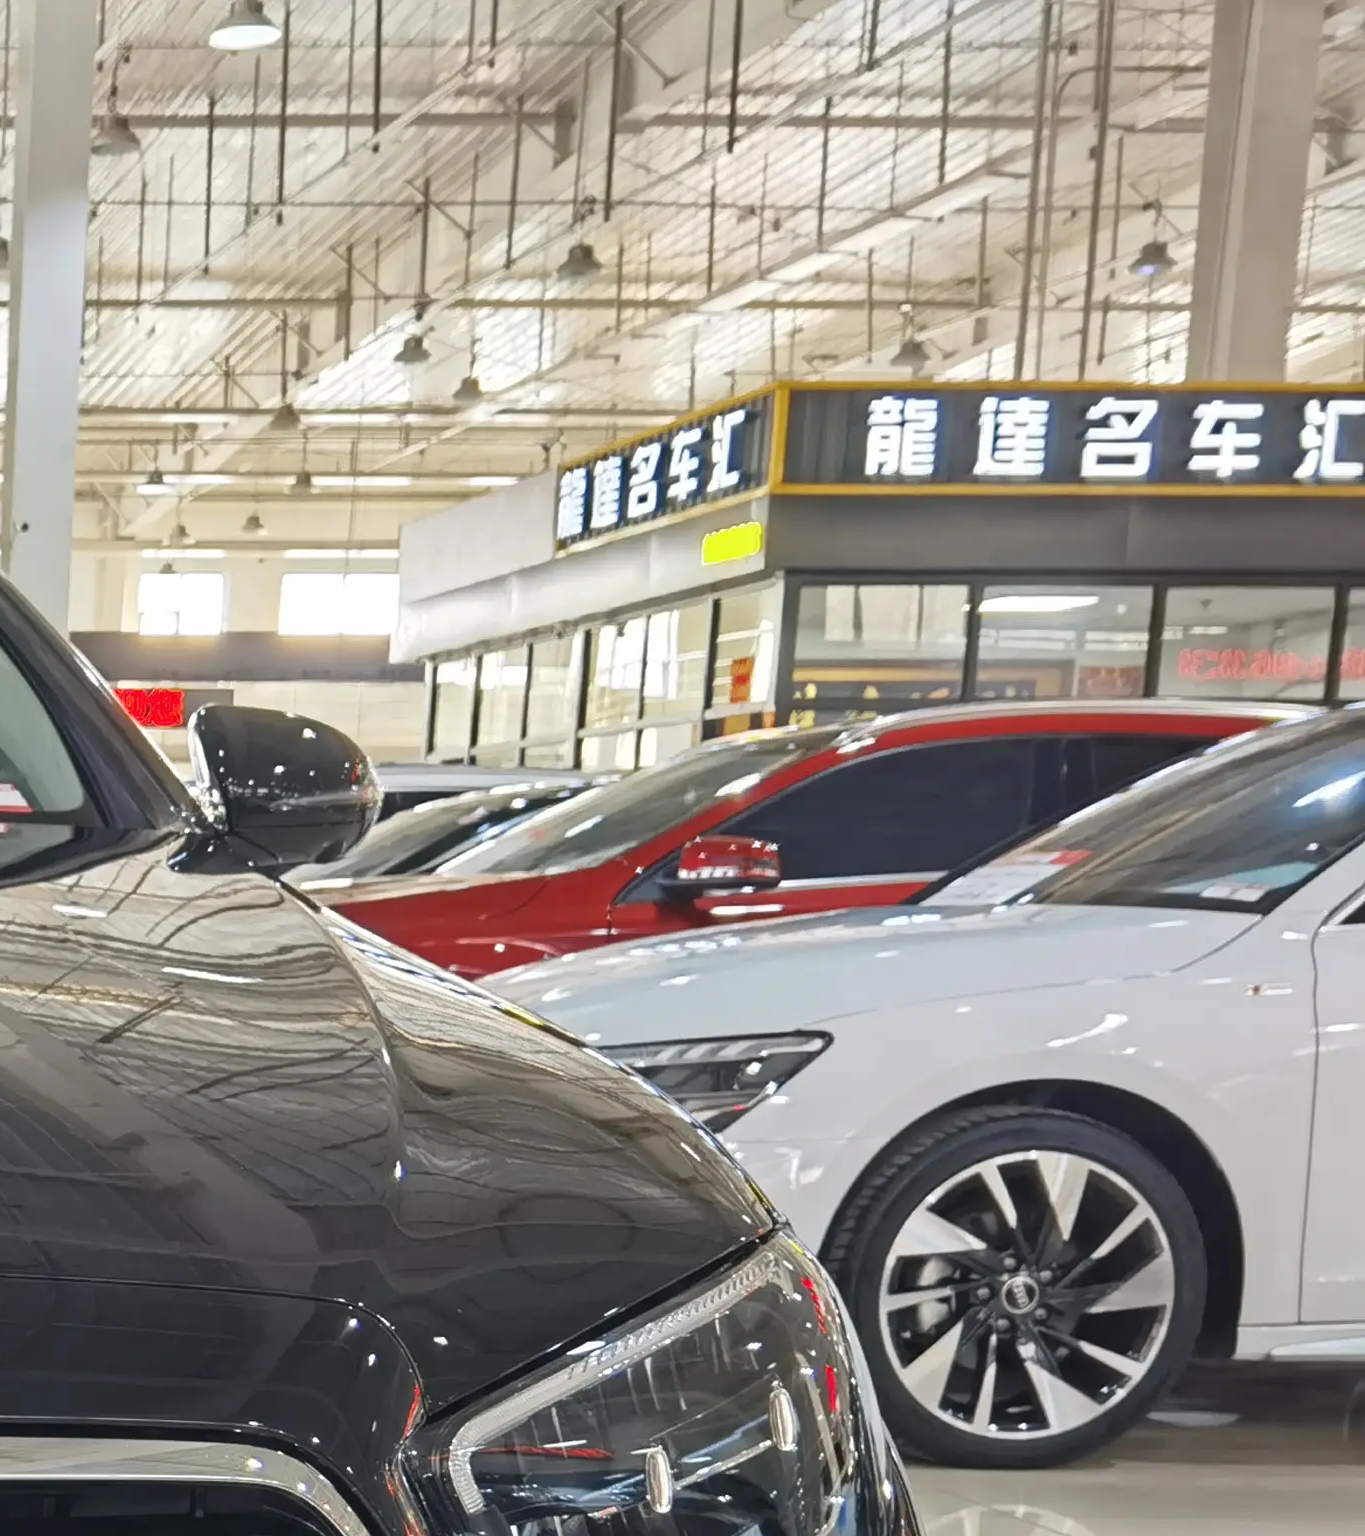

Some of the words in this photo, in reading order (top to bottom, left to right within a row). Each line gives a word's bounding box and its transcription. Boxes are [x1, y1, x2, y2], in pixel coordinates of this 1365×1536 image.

[556, 408, 747, 541] 龍達名车汇
[864, 396, 1365, 480] 龍達名车汇
